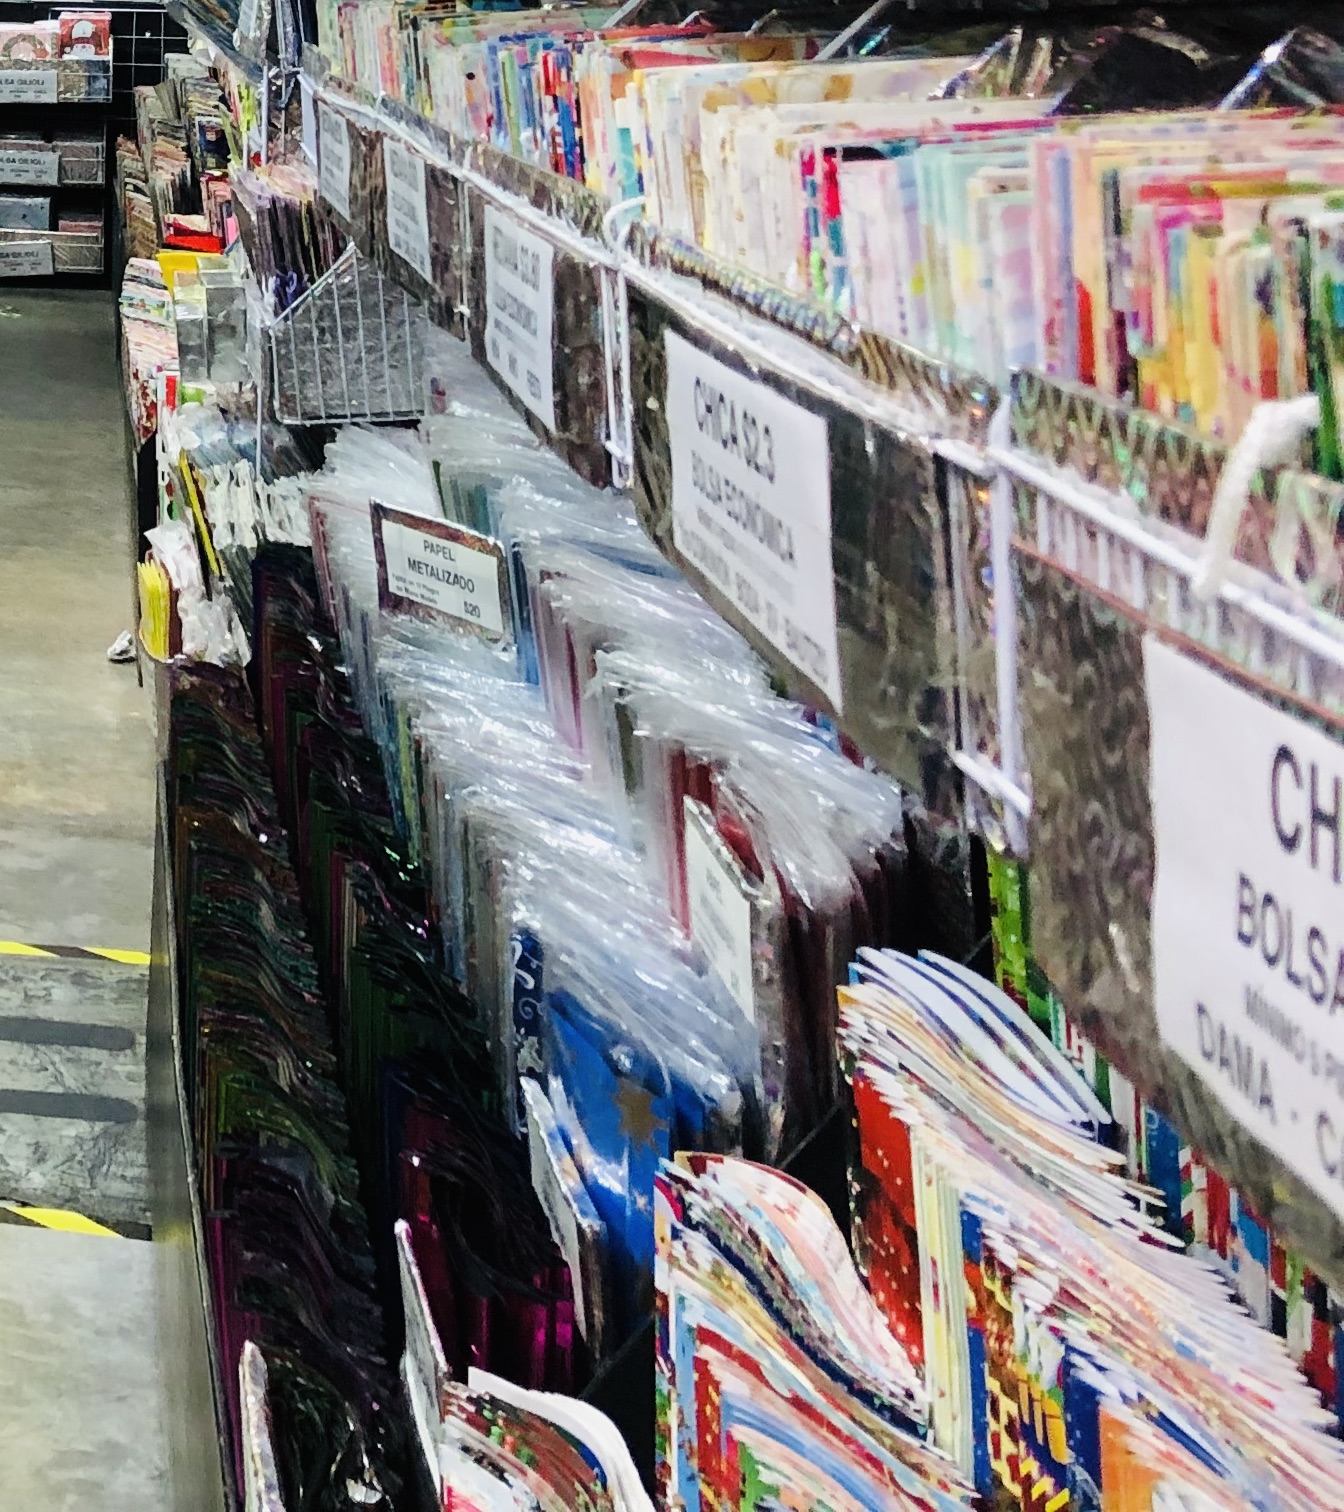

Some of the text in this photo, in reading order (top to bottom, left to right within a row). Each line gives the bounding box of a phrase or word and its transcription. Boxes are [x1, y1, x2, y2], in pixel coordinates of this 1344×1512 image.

[423, 539, 456, 562] PAPEL
[407, 557, 475, 594] METALIZADO
[463, 600, 481, 619] $20
[1270, 743, 1344, 885] CH
[1195, 1001, 1279, 1126] DAMA
